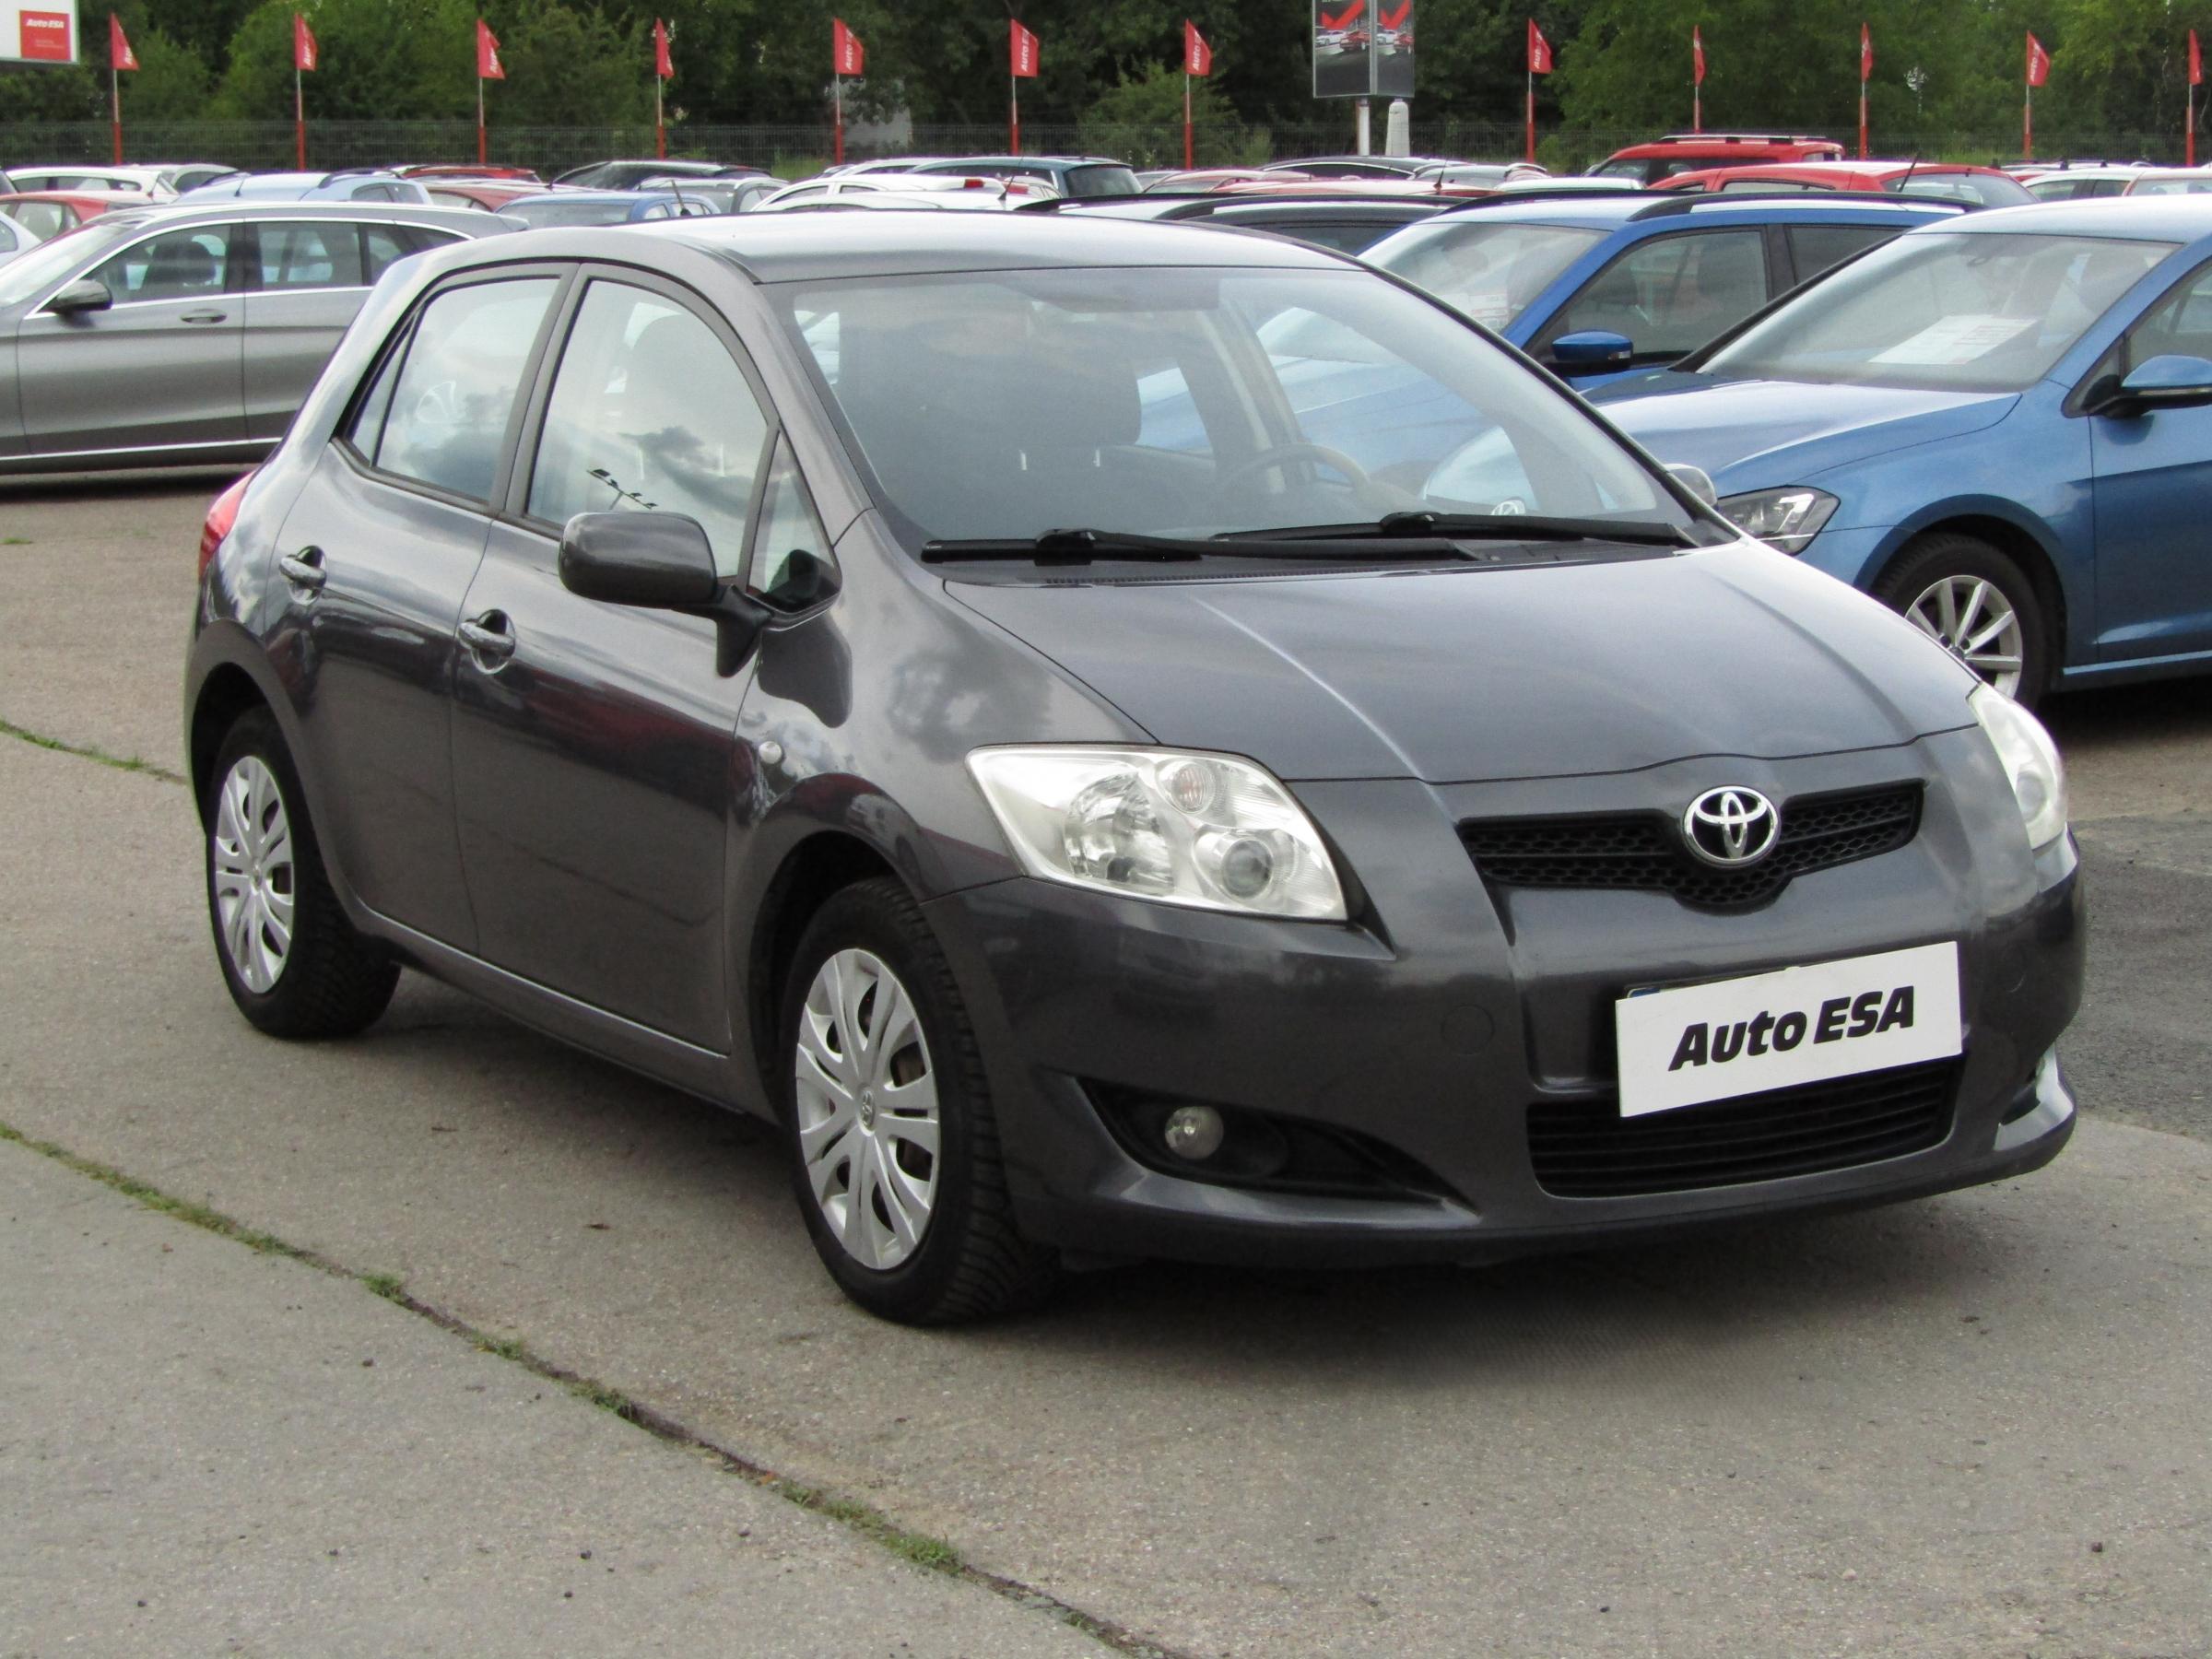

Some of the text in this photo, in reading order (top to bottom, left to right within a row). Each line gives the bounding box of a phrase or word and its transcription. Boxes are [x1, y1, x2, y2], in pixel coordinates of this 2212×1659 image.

[1020, 45, 1030, 72] Auto
[1192, 44, 1201, 71] Auto
[1668, 985, 1914, 1072] Auto ESA
